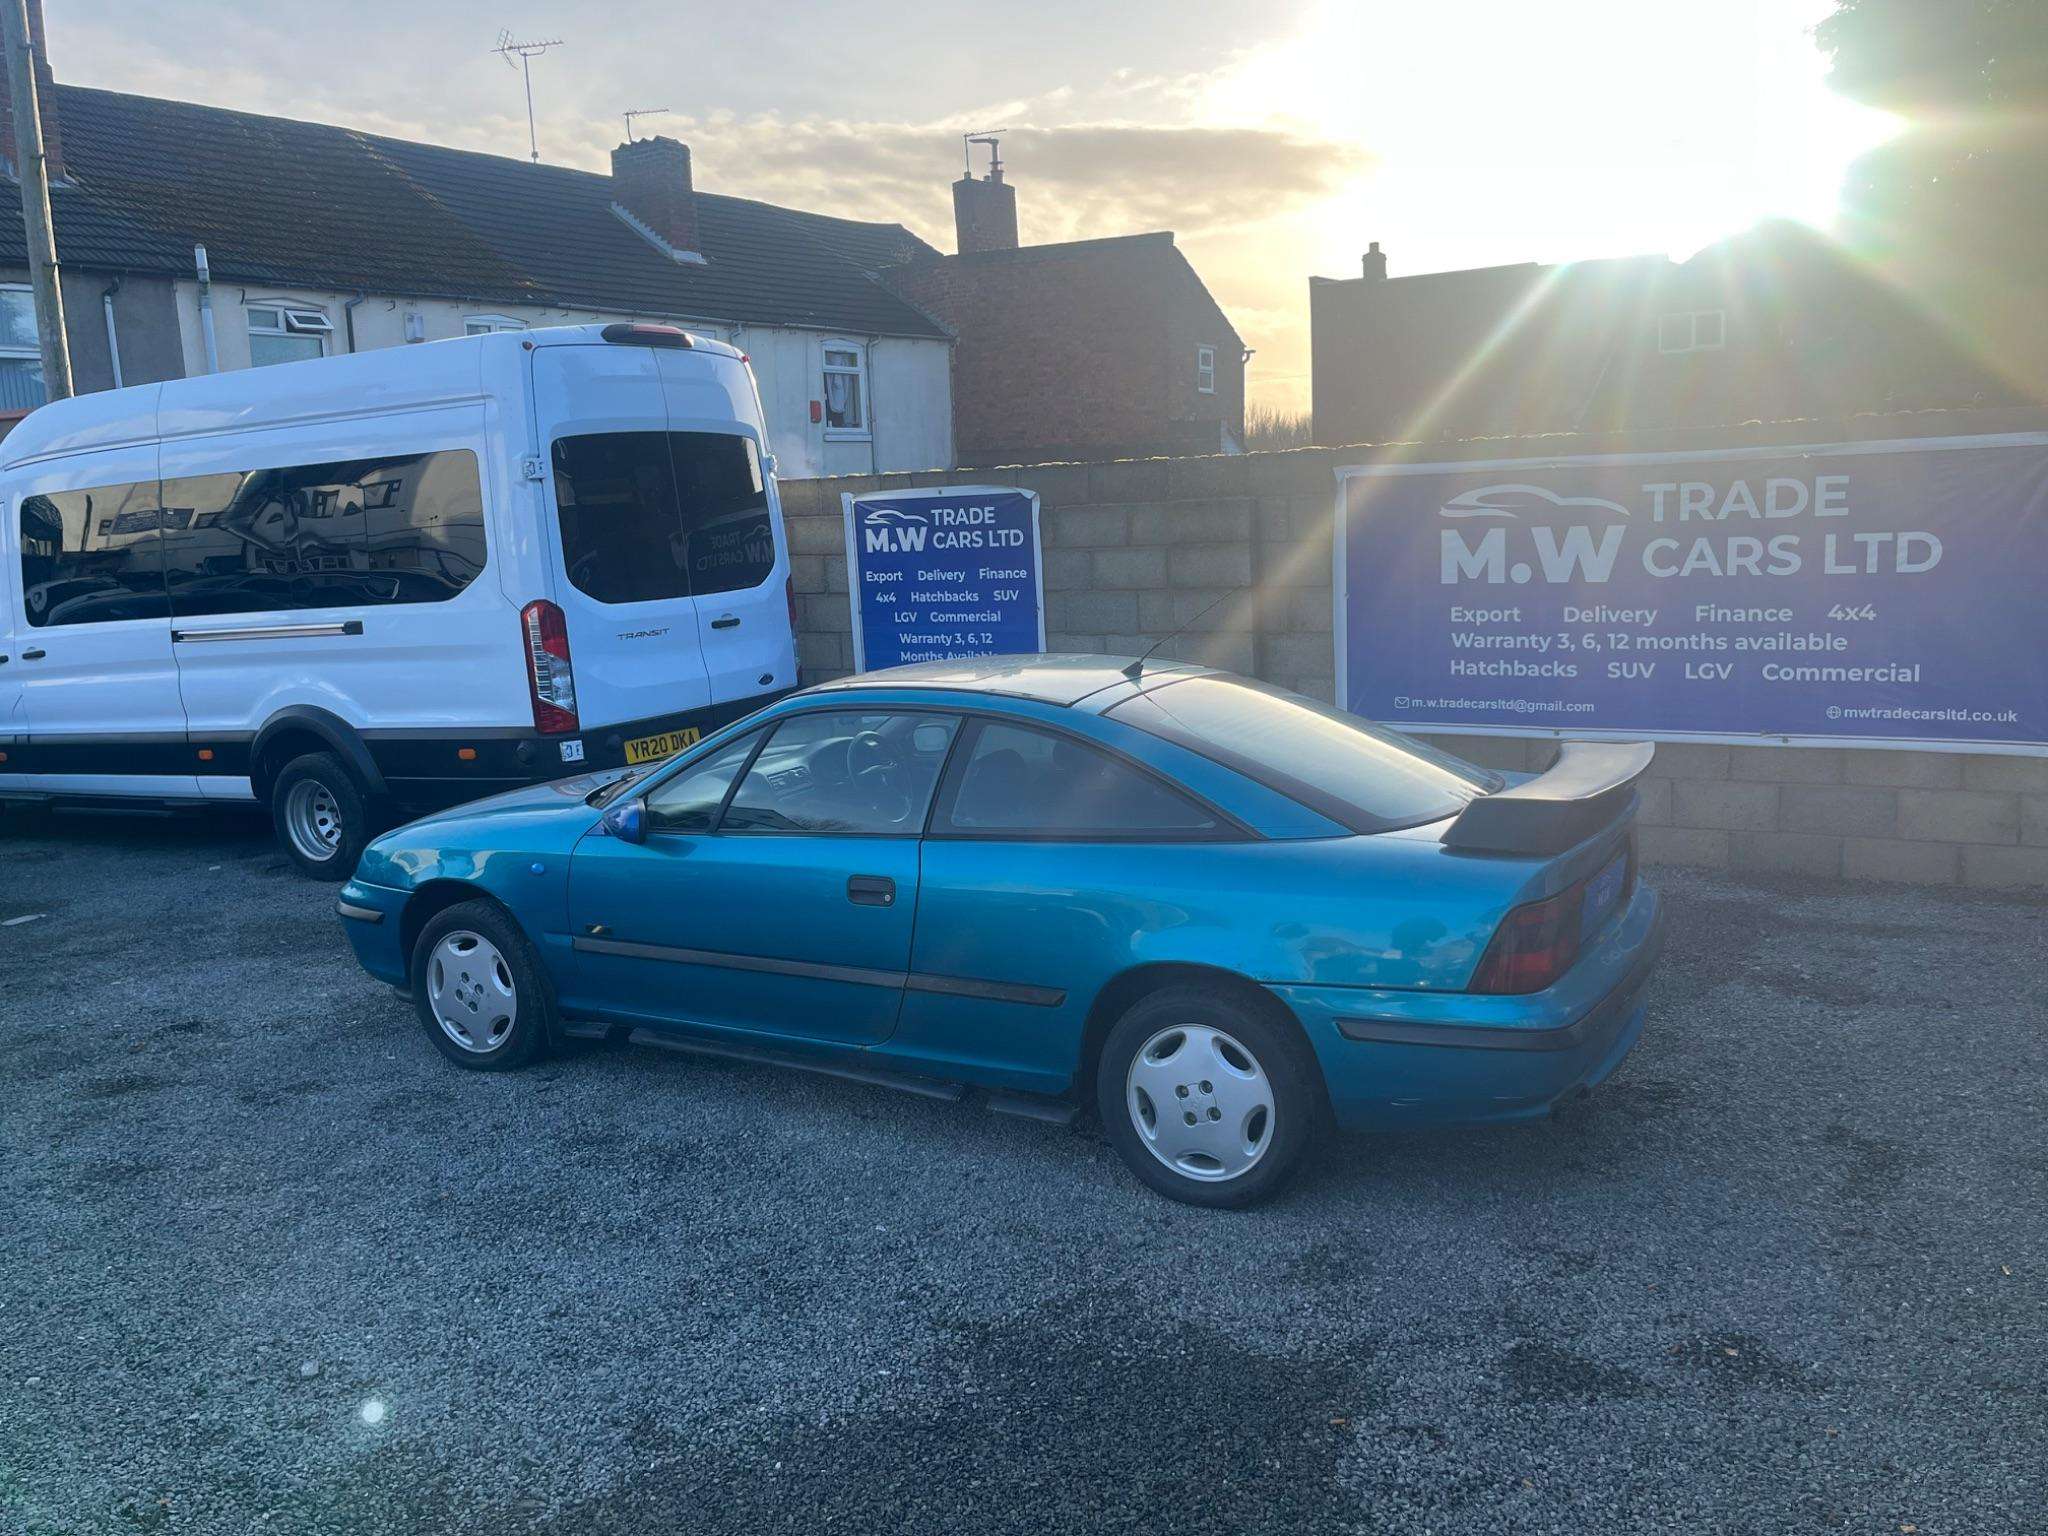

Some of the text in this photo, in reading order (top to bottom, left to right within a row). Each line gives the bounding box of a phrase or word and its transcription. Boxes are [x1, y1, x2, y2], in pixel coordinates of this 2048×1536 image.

[1642, 475, 1851, 522] TRADE
[931, 507, 996, 526] TRADE
[865, 526, 928, 553] M.W
[933, 529, 1024, 549] CARS LTD
[1440, 525, 1627, 584] M.W
[1642, 531, 1943, 578] CARS LTD
[866, 568, 1027, 583] Export Delivery Finance
[876, 590, 1019, 603] 4x4 Hatchbacks SUV
[895, 611, 1001, 623] LGV Commercial
[1450, 603, 1877, 627] Export Delivery Finance 4x4
[617, 628, 670, 640] TRANSIT
[900, 633, 993, 646] Warranty 3, 6, 12
[1451, 632, 1848, 652] Warranty 3, 6, 12 months available
[900, 651, 944, 662] Months
[1450, 660, 1921, 683] Hatchbacks SUV LGV Commercial
[1411, 698, 1595, 713] m.w.tradecarsltd@gmail.com
[1844, 707, 2018, 722] mwtradecarsltd.co.uk
[631, 731, 695, 759] YR20 DKA
